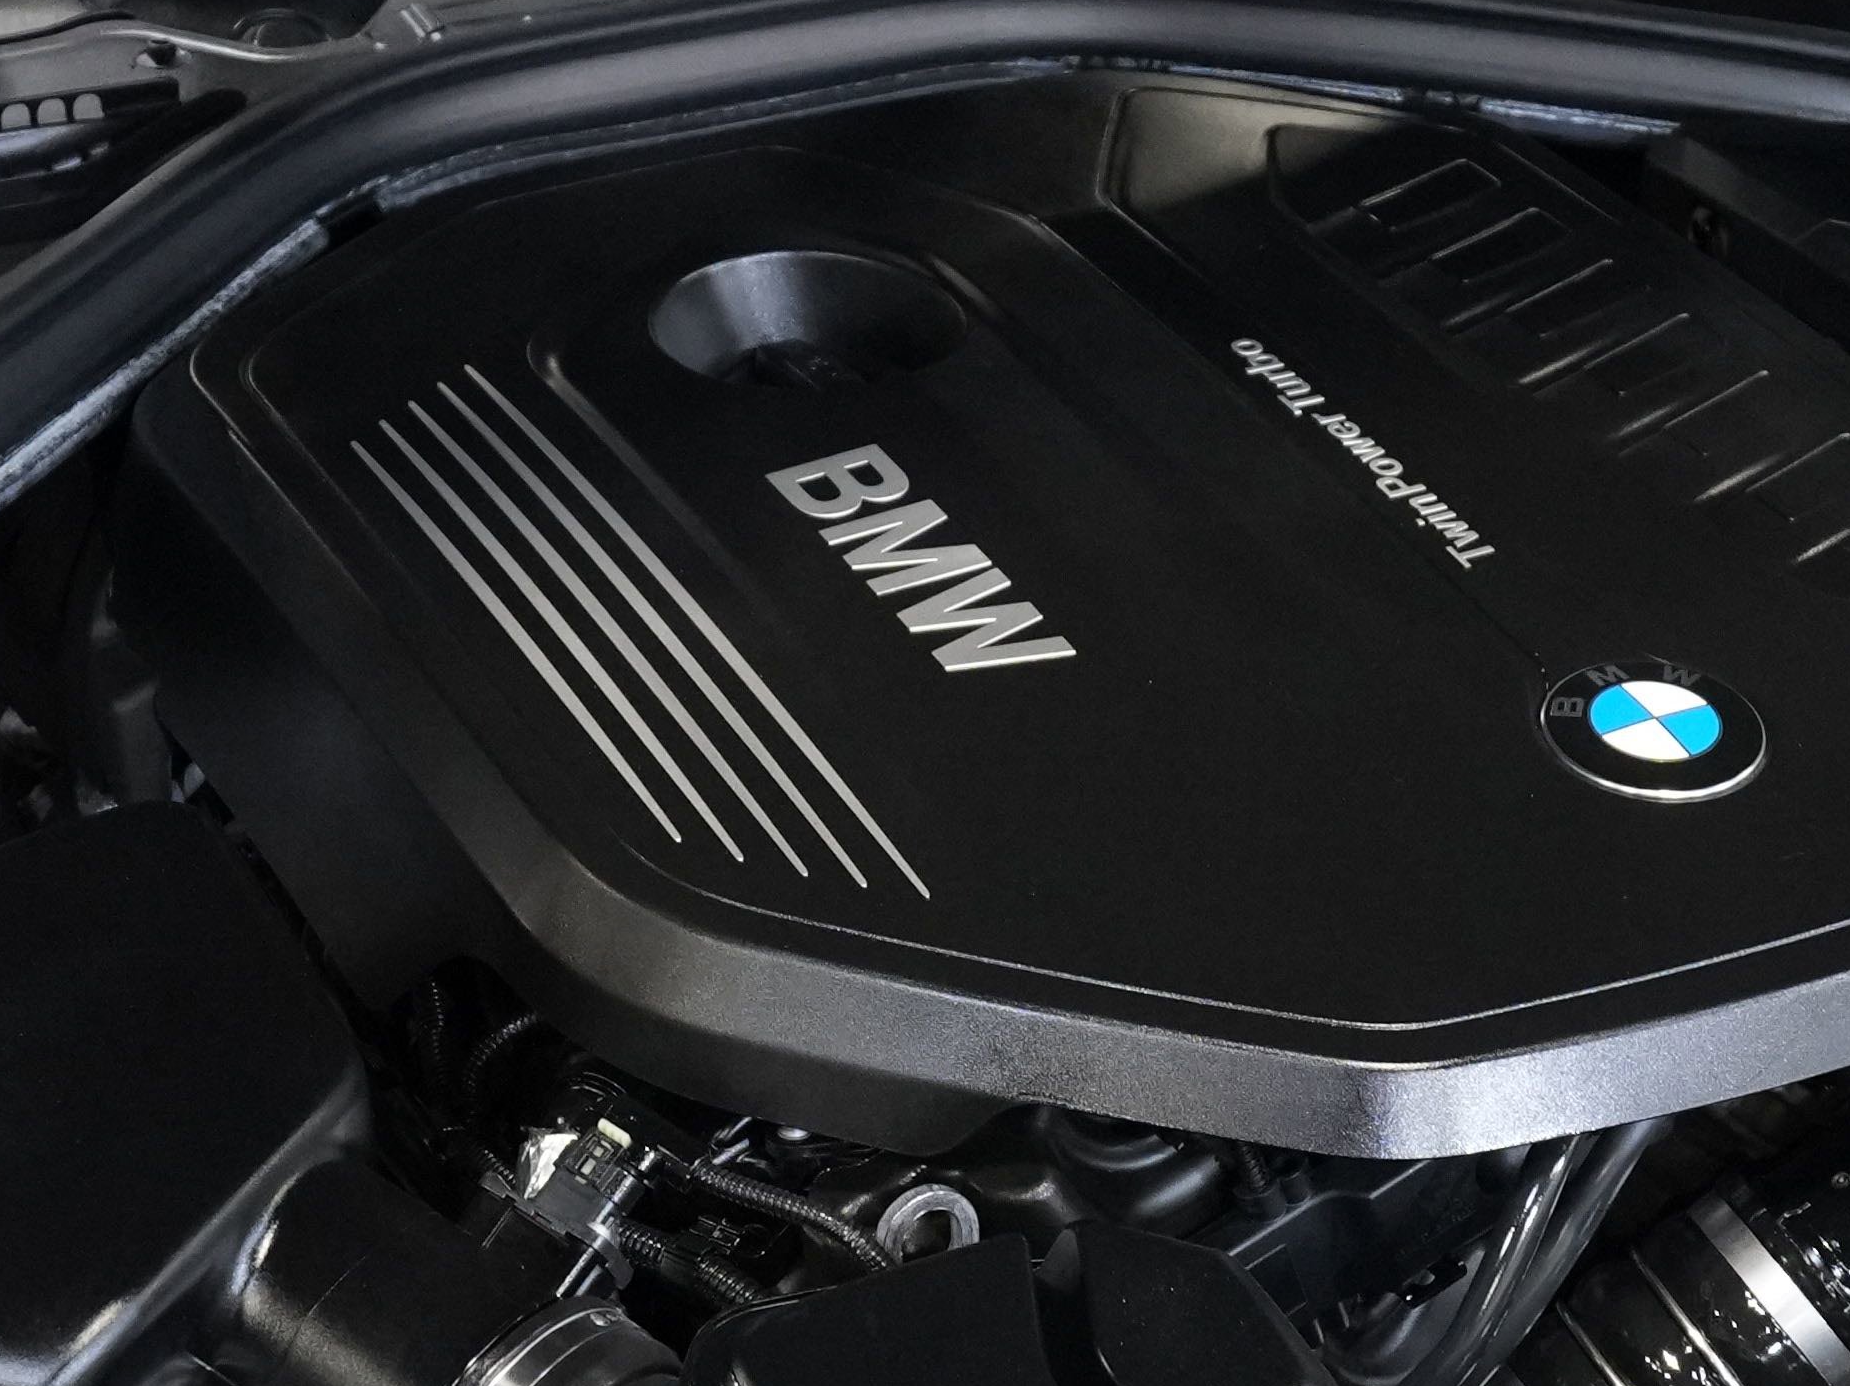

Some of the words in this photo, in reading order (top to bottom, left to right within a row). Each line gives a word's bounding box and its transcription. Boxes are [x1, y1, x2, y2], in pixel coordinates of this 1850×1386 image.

[1229, 336, 1326, 417] Turbo
[1311, 412, 1496, 570] TwinPower
[764, 443, 1077, 672] BMW
[1550, 664, 1701, 718] BMW
